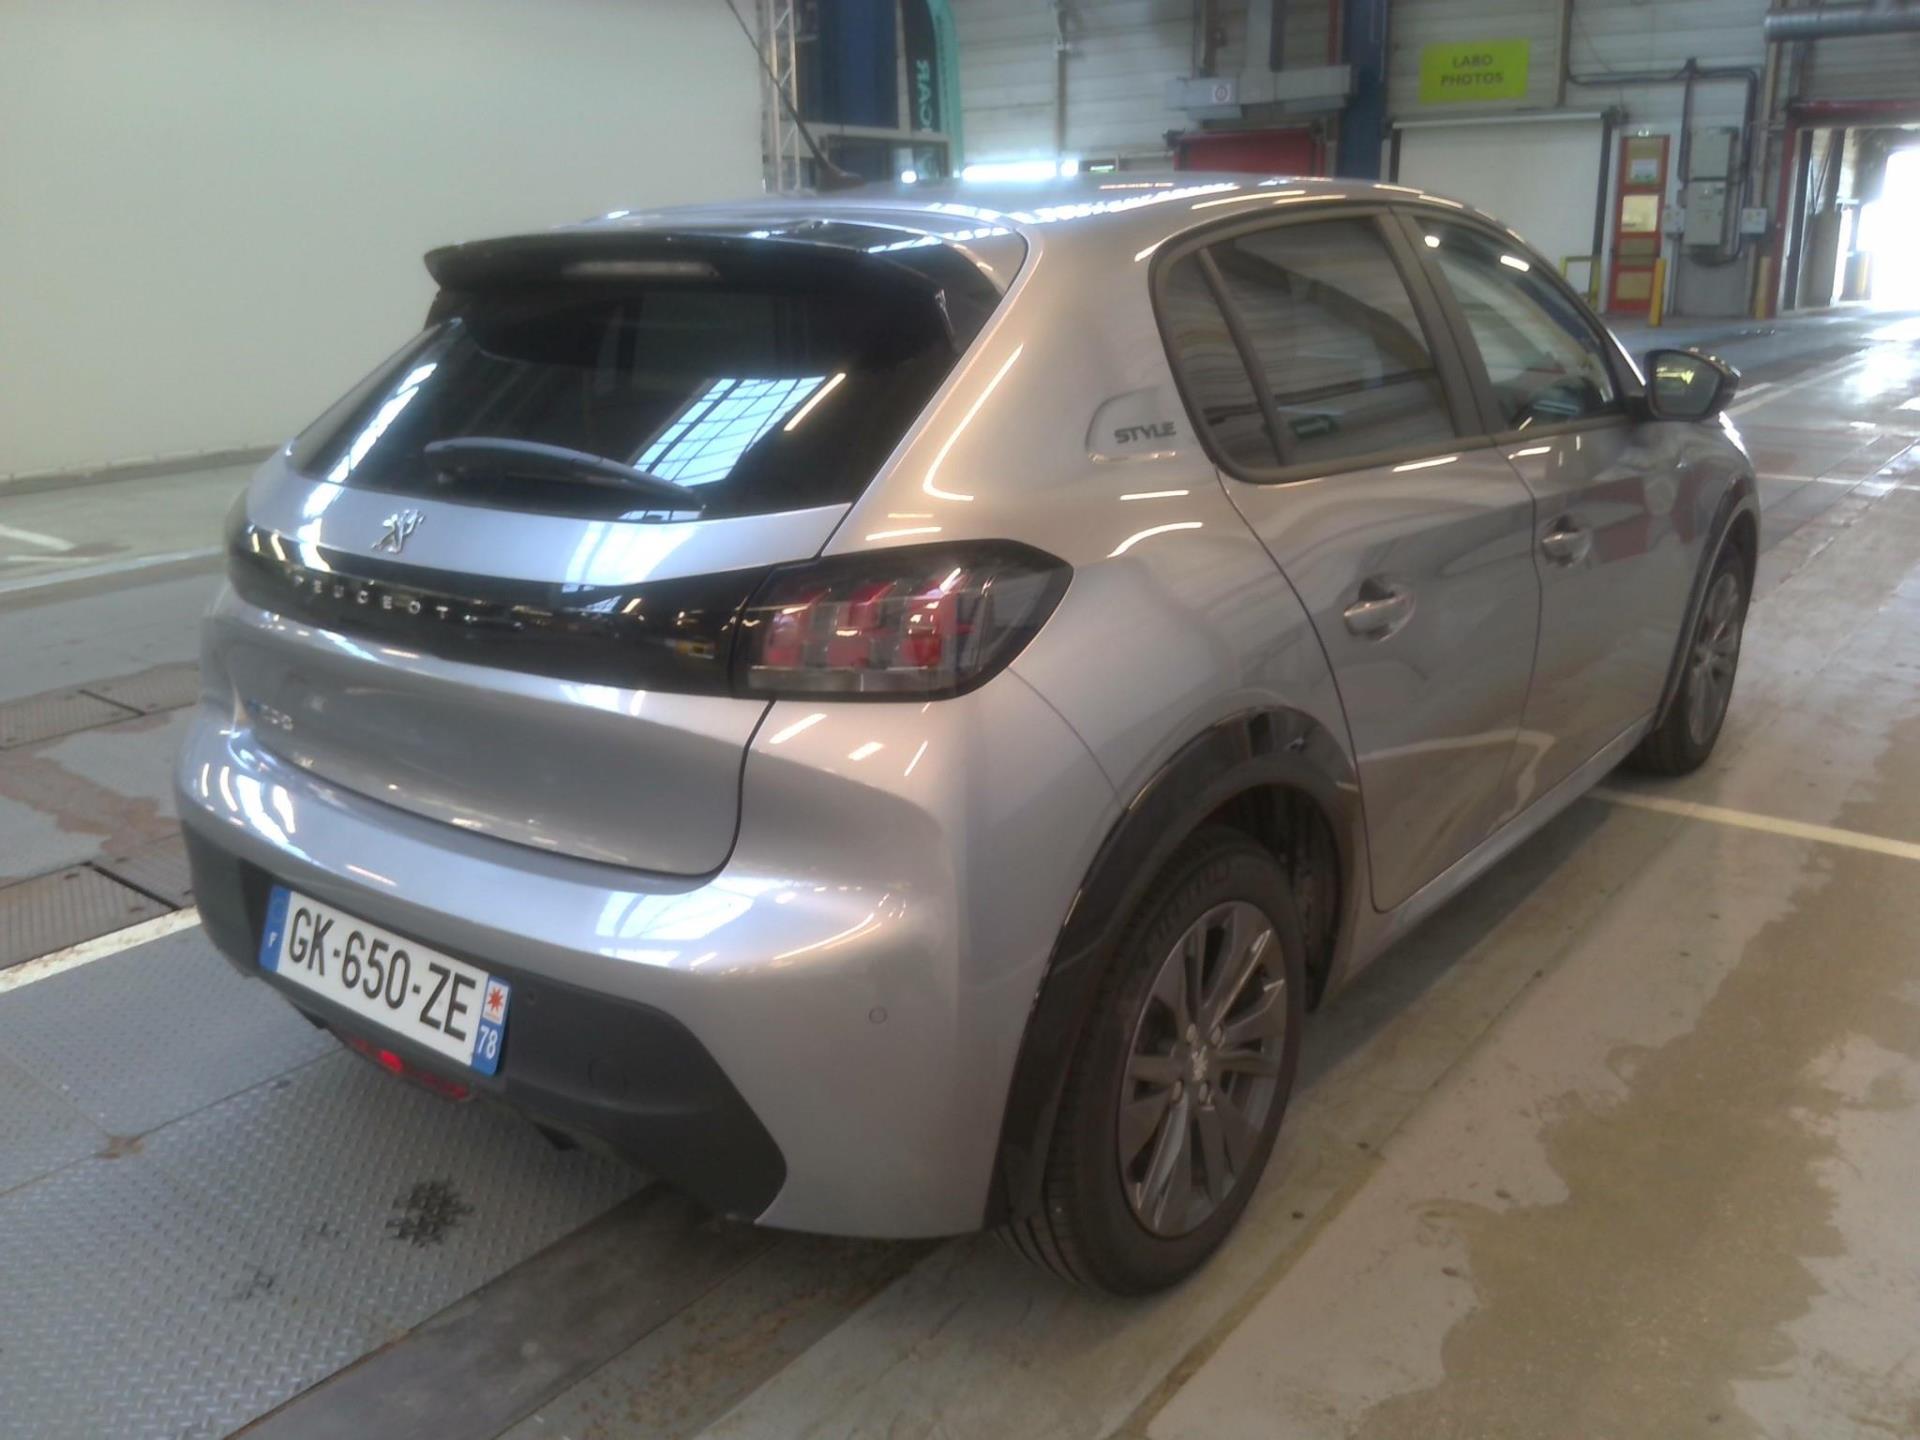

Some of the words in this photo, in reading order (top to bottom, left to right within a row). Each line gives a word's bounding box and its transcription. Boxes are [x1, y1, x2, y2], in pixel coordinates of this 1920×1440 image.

[1452, 54, 1494, 69] LABO
[1440, 71, 1504, 87] PHOTOS
[1114, 421, 1177, 444] STYLE
[293, 573, 450, 620] PEUGEOT
[288, 906, 477, 1043] GK-650-ZE
[477, 1024, 498, 1060] 78
